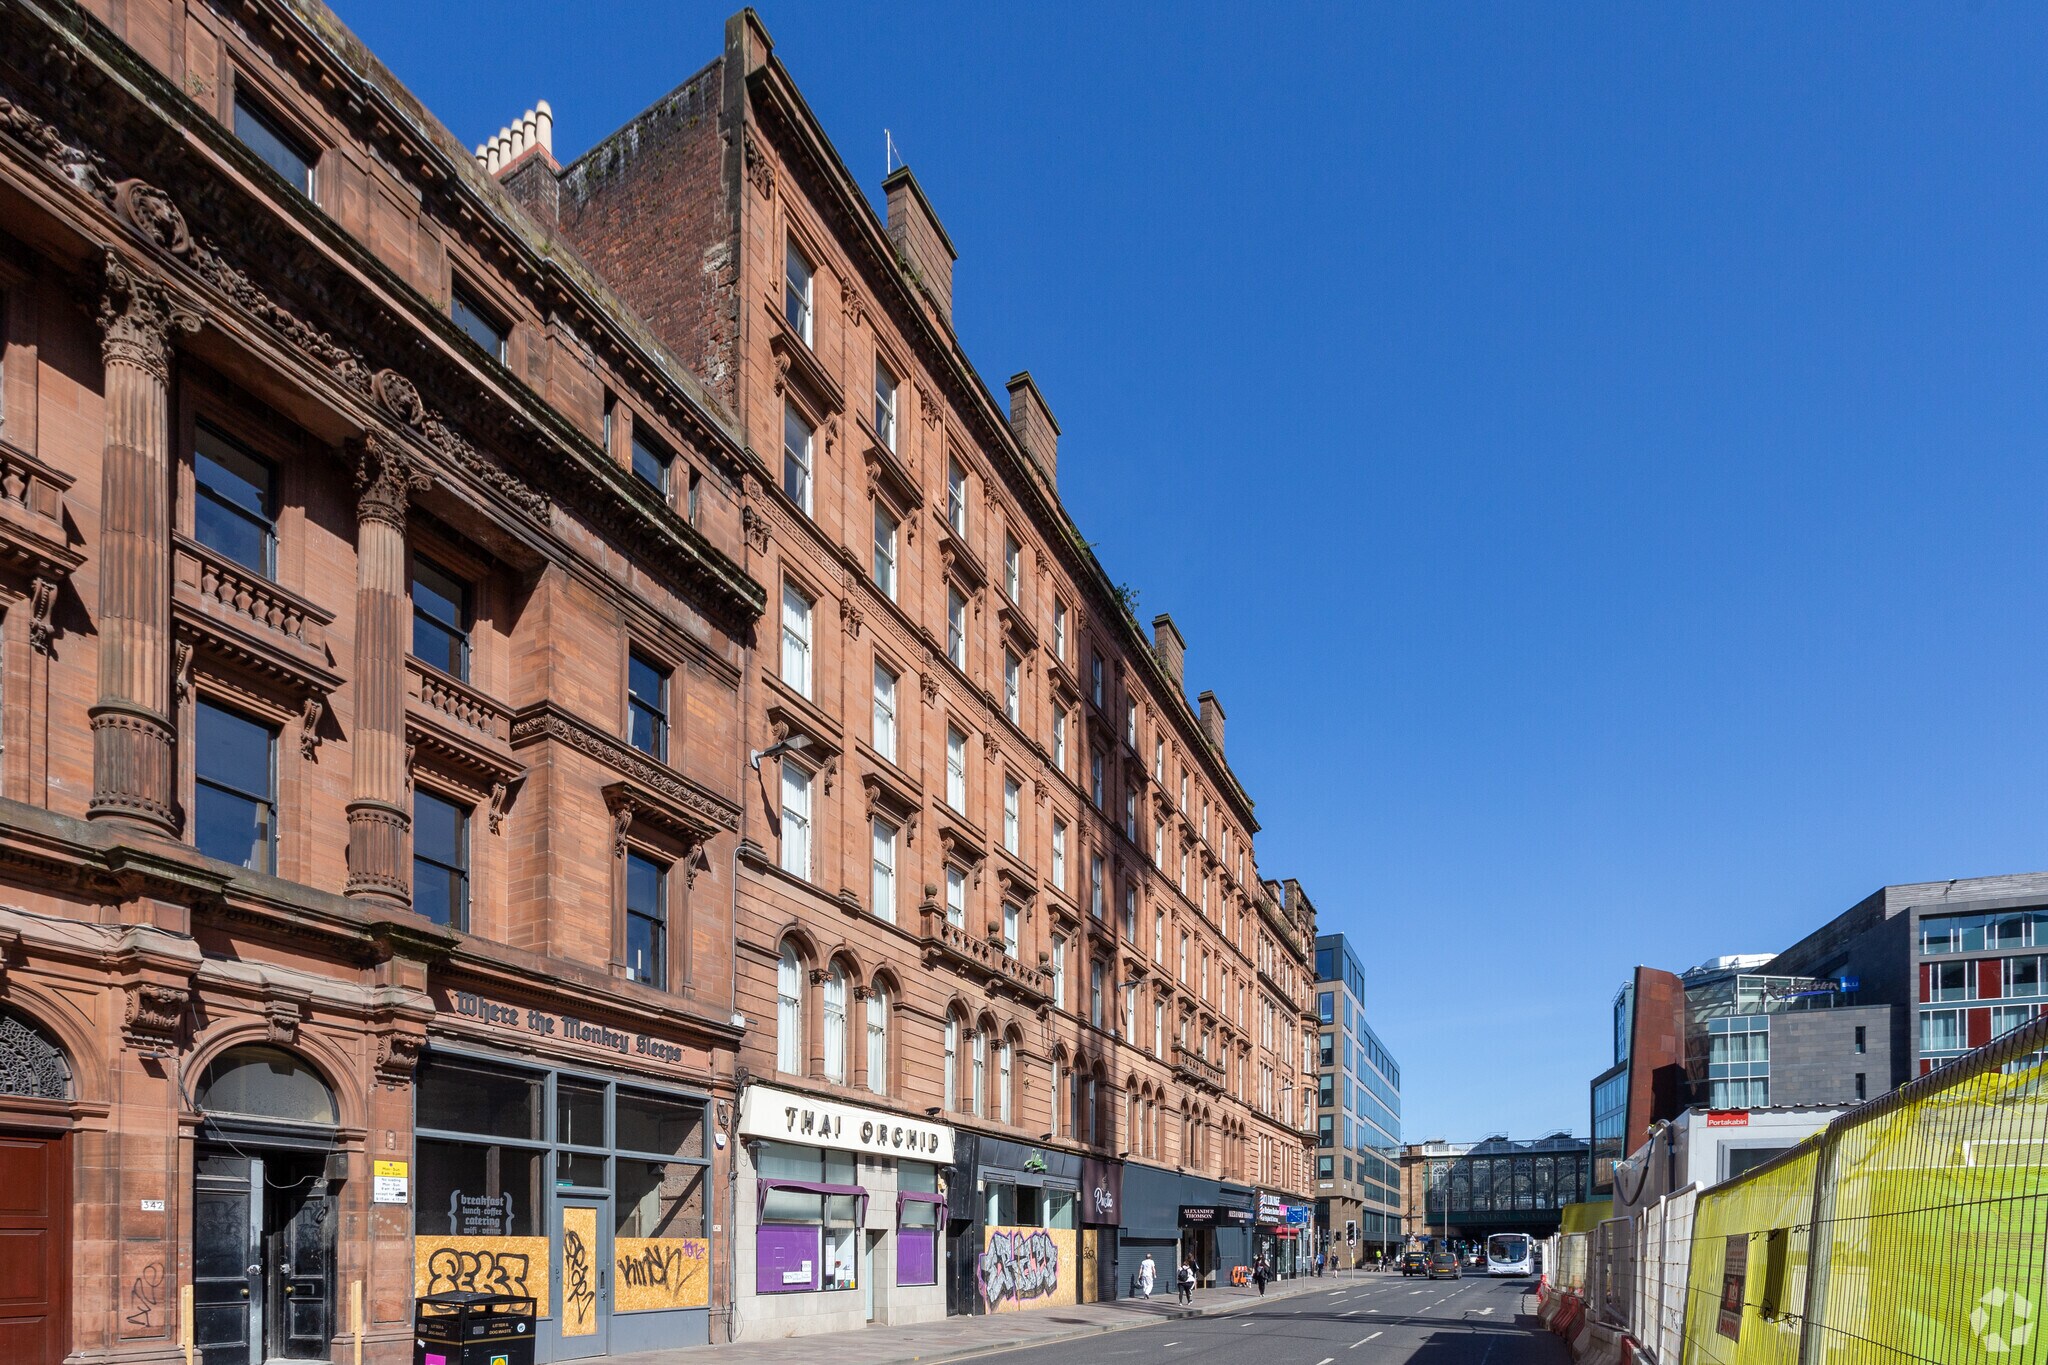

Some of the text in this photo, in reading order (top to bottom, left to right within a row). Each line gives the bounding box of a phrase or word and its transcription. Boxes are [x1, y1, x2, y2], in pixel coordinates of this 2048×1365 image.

[1761, 977, 1839, 1004] Radisson
[456, 991, 682, 1063] Where the Monkey Sleeps
[784, 1106, 938, 1152] THAI ORCHID
[144, 1201, 163, 1209] 342
[461, 1195, 504, 1207] breakfast
[463, 1206, 502, 1216] lunch coffee
[465, 1216, 500, 1228] catering
[464, 1227, 477, 1235] wifi
